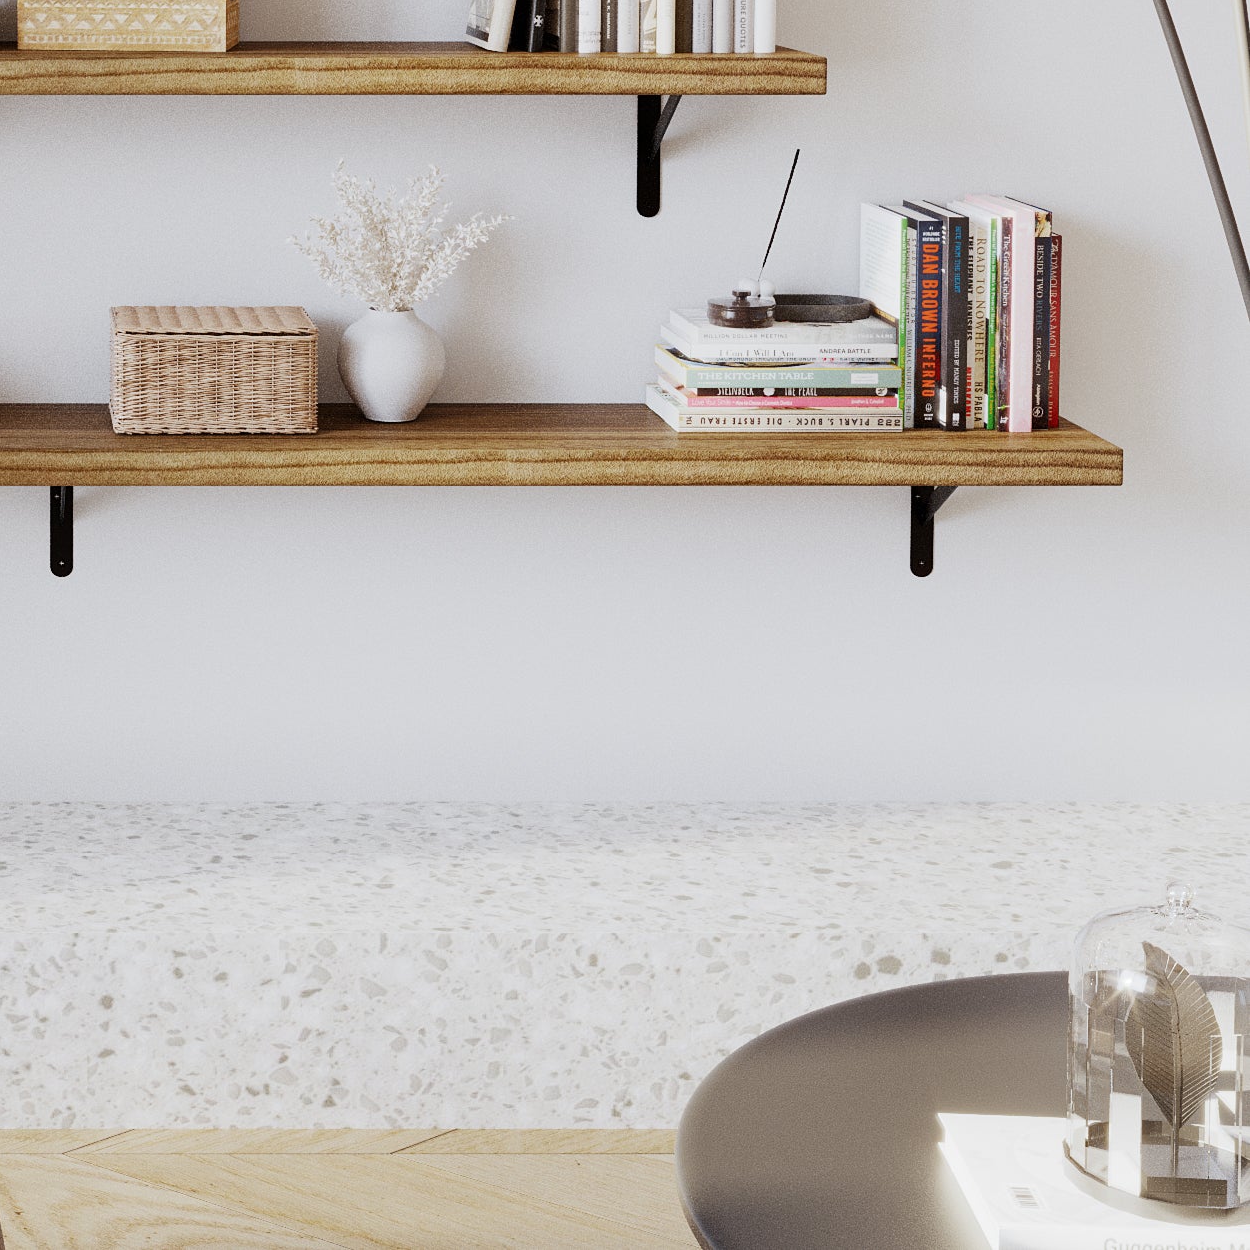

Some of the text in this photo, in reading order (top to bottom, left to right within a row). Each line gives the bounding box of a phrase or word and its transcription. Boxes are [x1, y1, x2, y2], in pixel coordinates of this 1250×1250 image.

[739, 17, 747, 49] QUOTES
[1003, 234, 1011, 307] The Green Kitchen
[1036, 244, 1045, 331] BESIDE TWO RIVERS
[922, 243, 939, 397] DAN BROWN INFERNO
[975, 238, 987, 363] ROAD TO NOWHERE
[697, 372, 815, 380] THE KITCHEN TABLE
[975, 381, 983, 422] HS PABLA
[699, 417, 870, 426] PEARL S. BUCK DIE ERSTE FRAU
